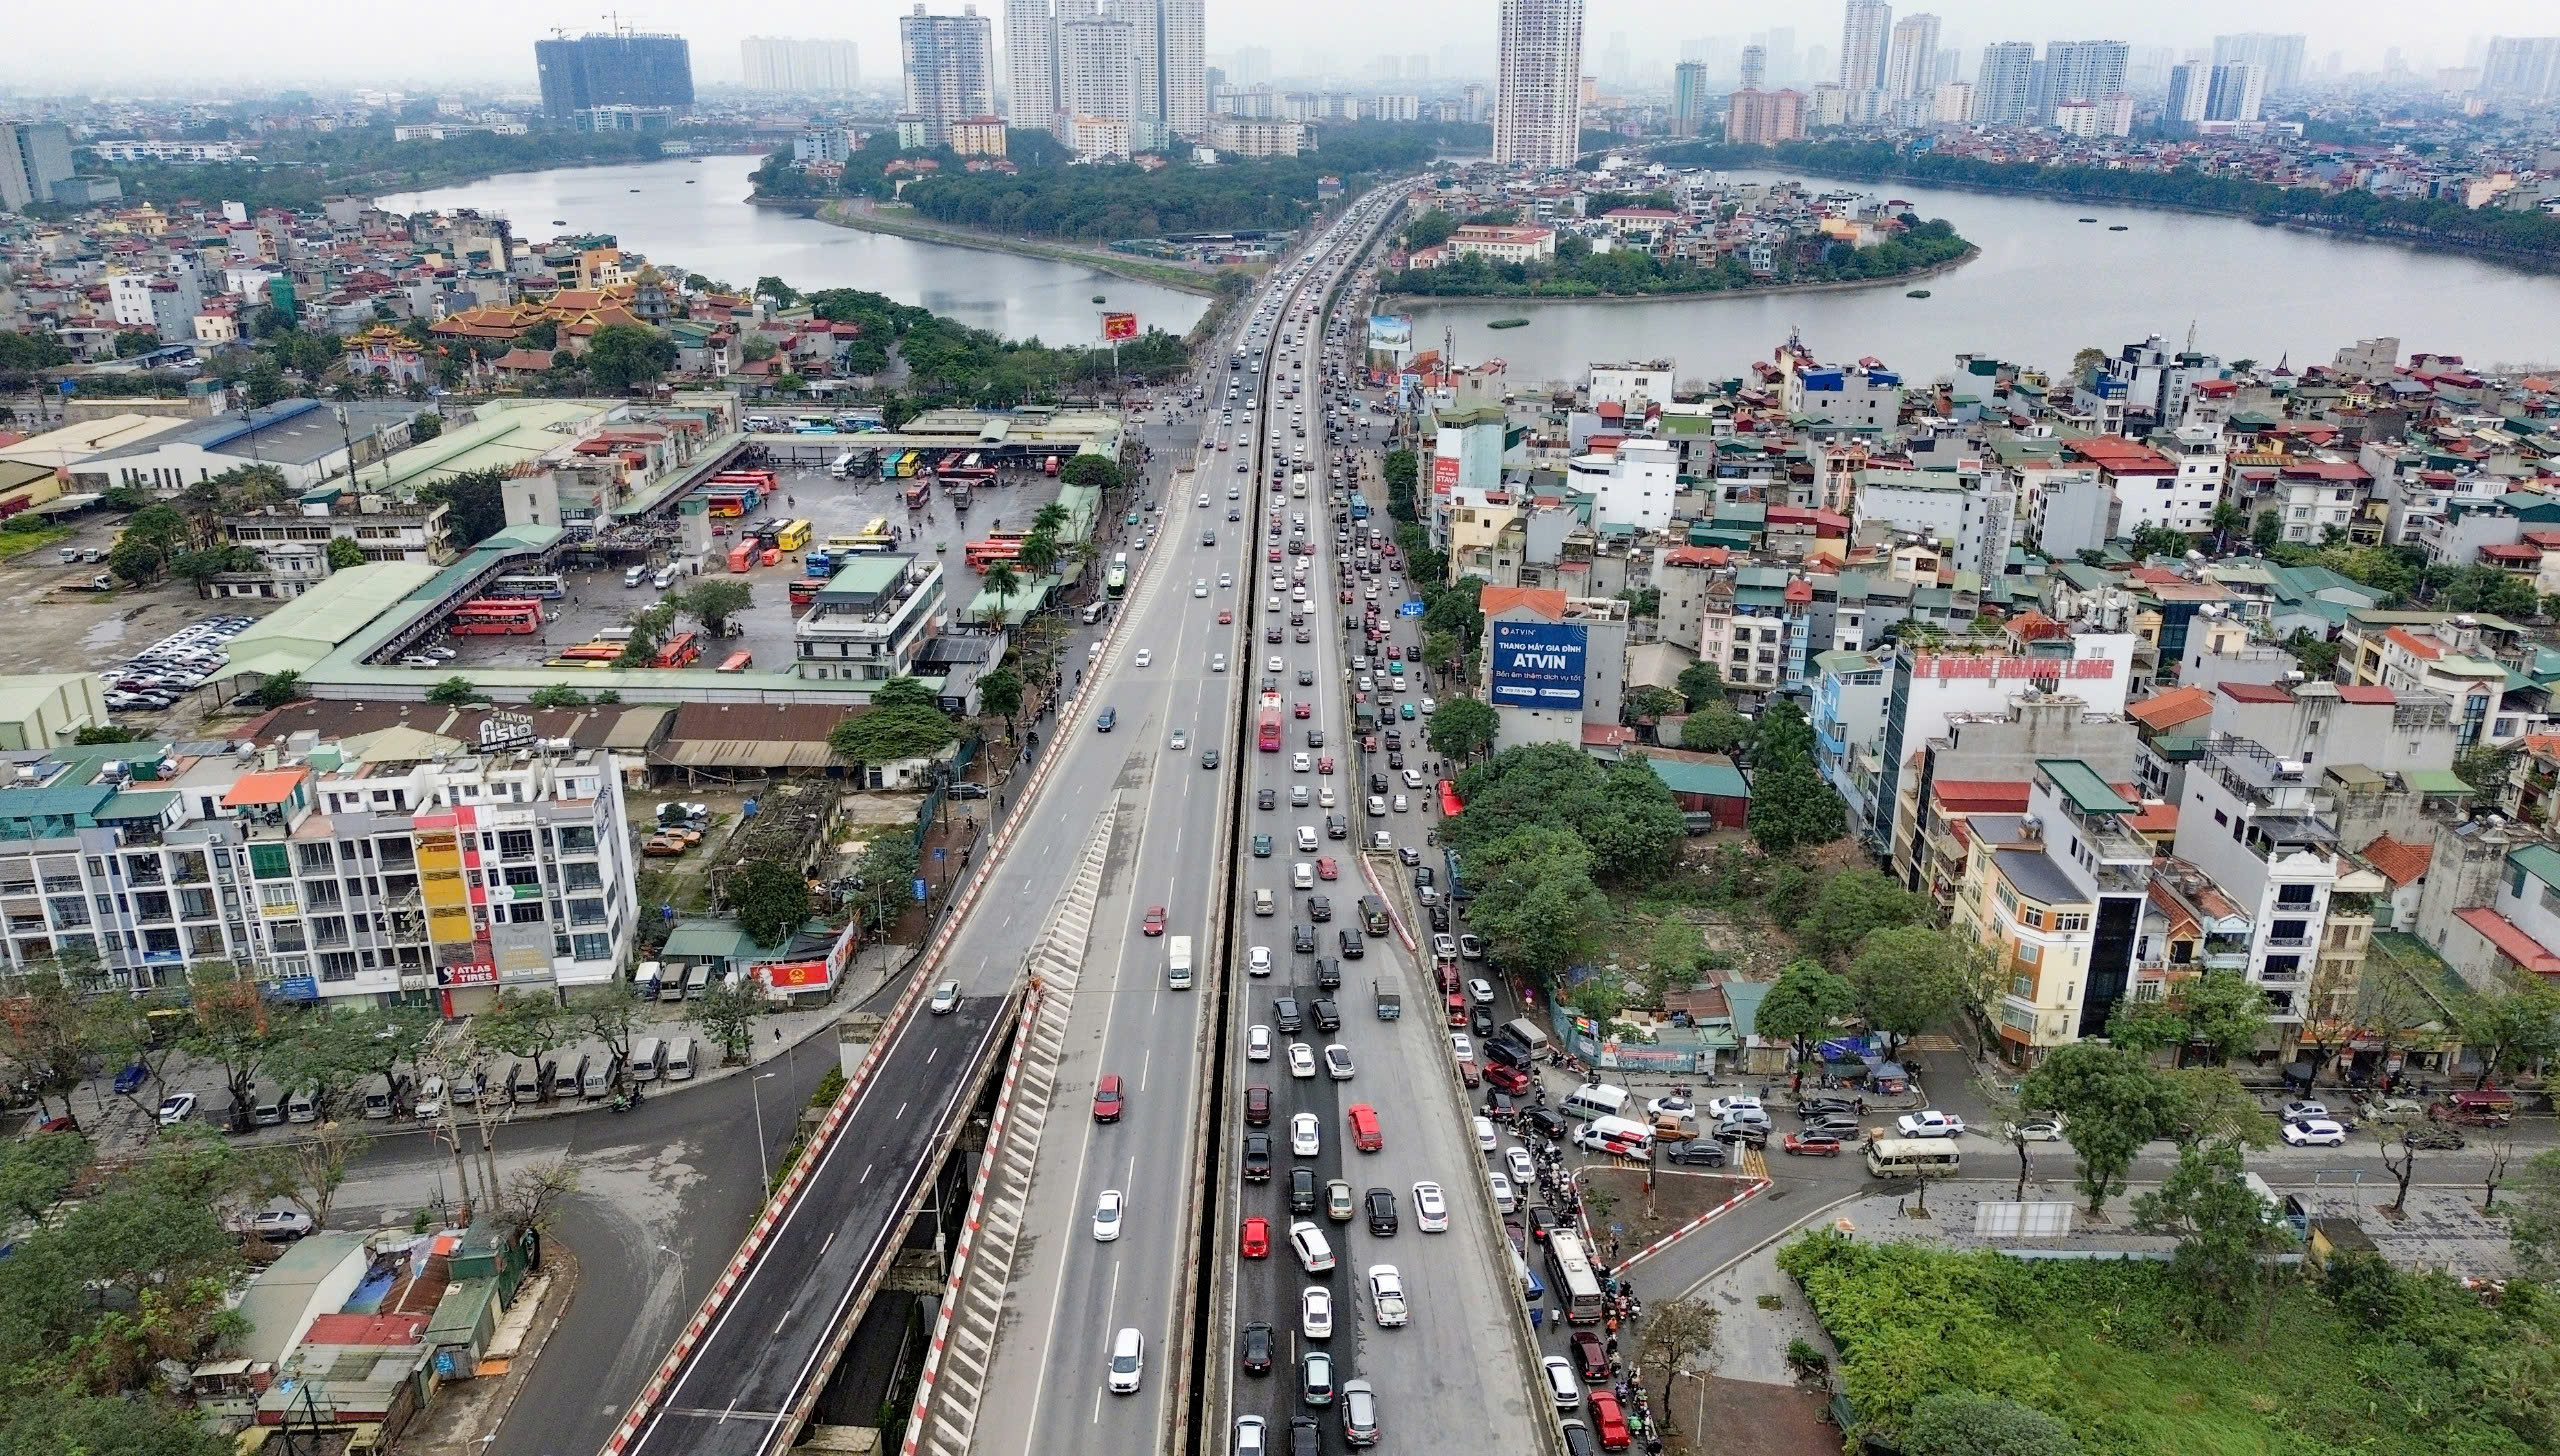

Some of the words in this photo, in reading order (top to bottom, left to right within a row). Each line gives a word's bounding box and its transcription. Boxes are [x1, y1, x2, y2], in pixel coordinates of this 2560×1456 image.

[1498, 642, 1526, 650] THANG
[1527, 642, 1545, 652] MÁY
[1561, 643, 1582, 653] ĐÌNH
[1513, 653, 1566, 669] ATVIN
[2066, 659, 2114, 679] LONG
[457, 965, 491, 974] ATLAS
[459, 973, 493, 982] TIRES
